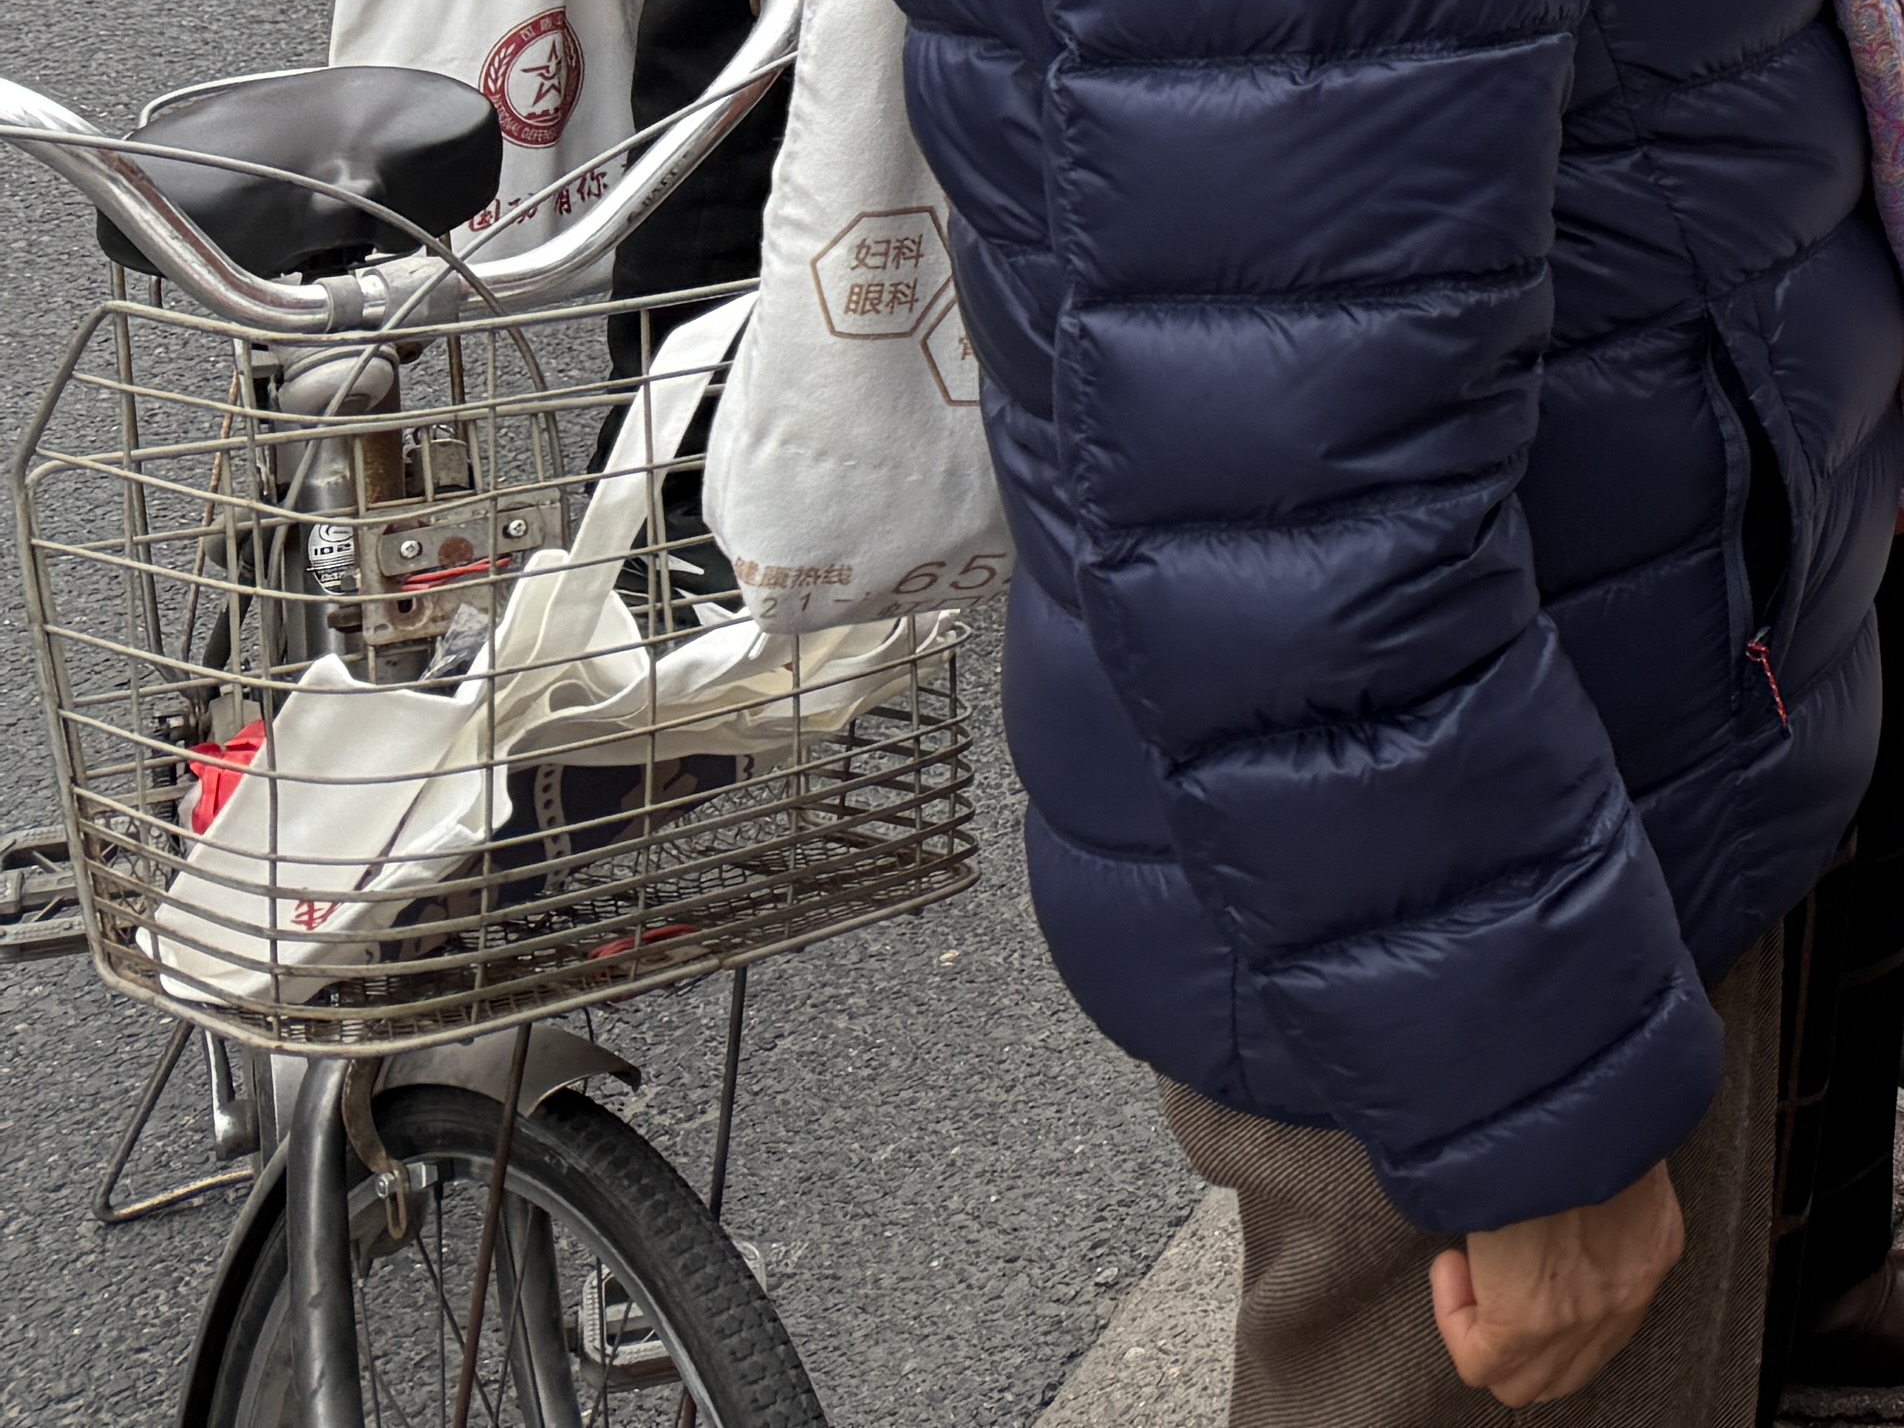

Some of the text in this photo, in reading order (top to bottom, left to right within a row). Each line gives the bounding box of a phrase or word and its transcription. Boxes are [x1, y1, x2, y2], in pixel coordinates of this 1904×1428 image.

[850, 234, 924, 270] 妇科
[843, 277, 919, 316] 眼科
[893, 552, 1013, 595] 65
